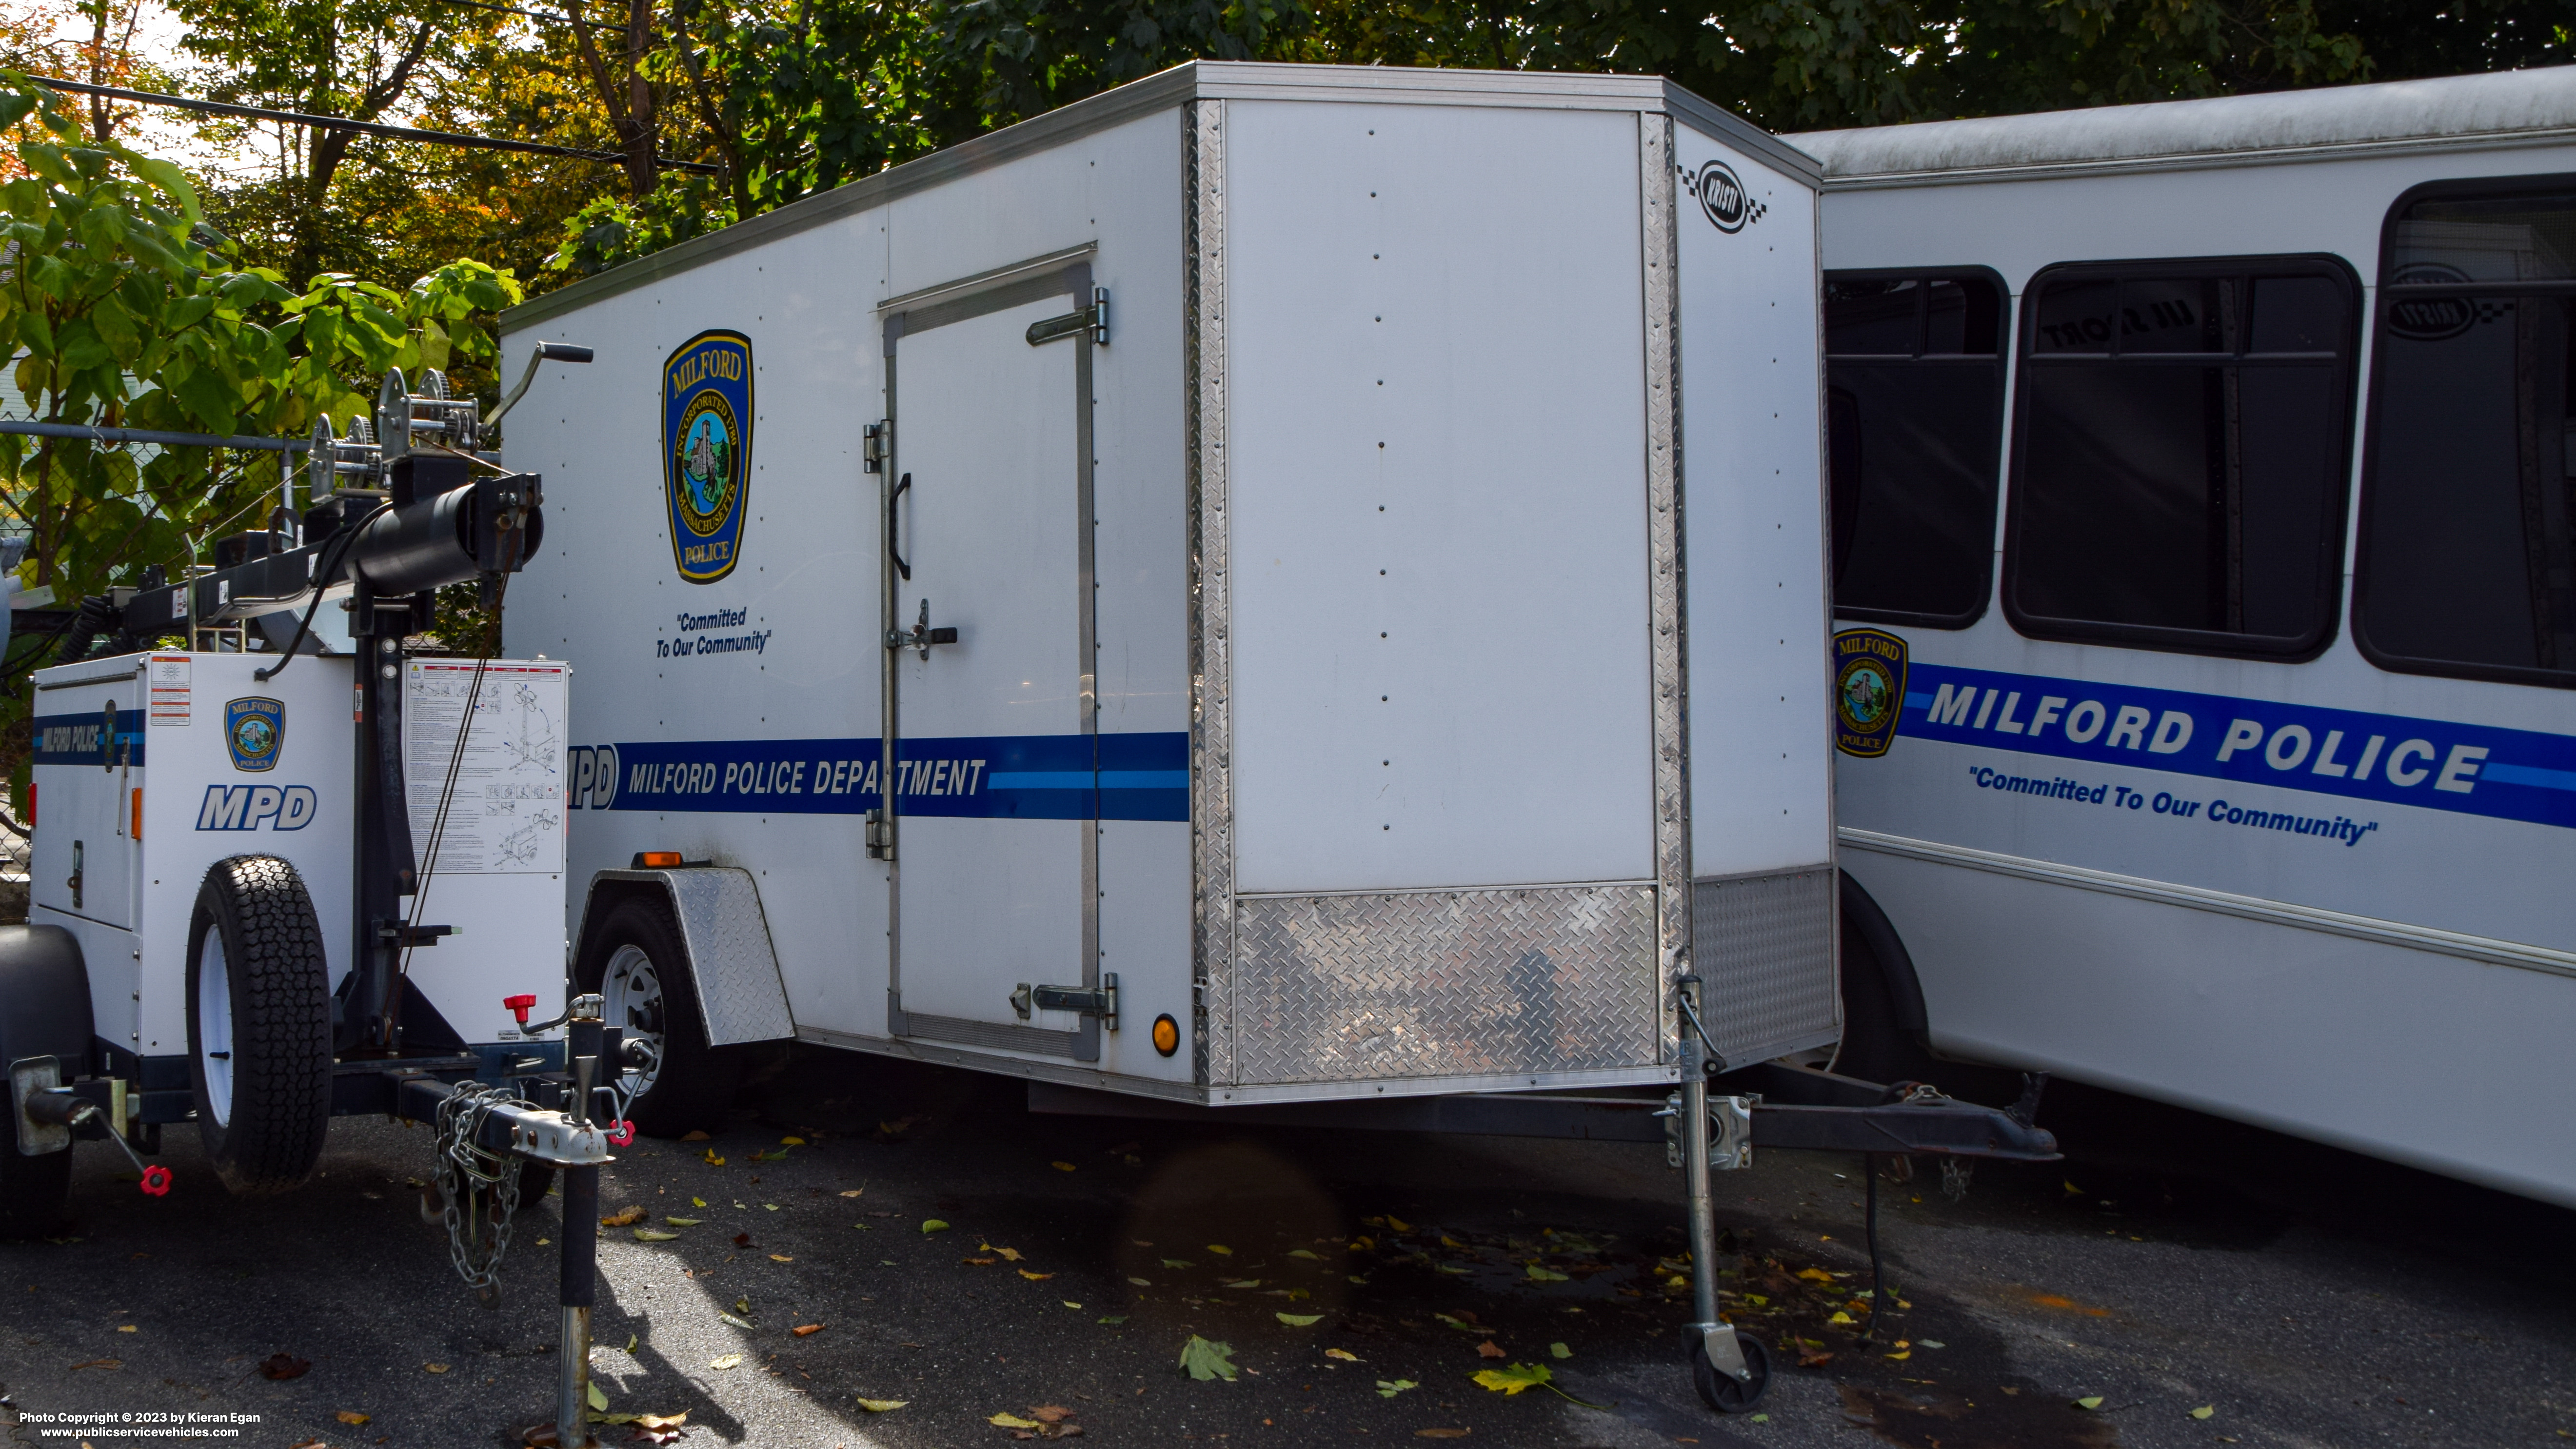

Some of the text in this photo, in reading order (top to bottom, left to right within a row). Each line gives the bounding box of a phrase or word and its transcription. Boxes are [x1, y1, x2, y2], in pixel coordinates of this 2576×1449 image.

[1707, 178, 1738, 214] KRISTI
[673, 350, 741, 399] MILFORD
[676, 396, 737, 457] INCORPORATED 1780
[678, 483, 735, 532] MASSACHUSETTS
[685, 541, 730, 565] POLICE
[677, 606, 747, 632] "Committed
[657, 629, 771, 658] To Our Community"
[1839, 637, 1899, 661] MILFORD
[1839, 660, 1885, 686] INCORPORATED
[232, 702, 278, 715] MILFORD
[1839, 705, 1889, 730] MASSACHUSETTS
[42, 725, 99, 752] MILFORD POLICE
[1842, 734, 1881, 748] POLICE
[1927, 683, 2489, 794] MILFORD POLICE
[629, 762, 716, 794] MILFORD
[723, 761, 806, 794] POLICE
[813, 759, 986, 795] DEPATMENT
[195, 785, 317, 831] MPD
[1969, 766, 2378, 847] "Committed To Our Community"
